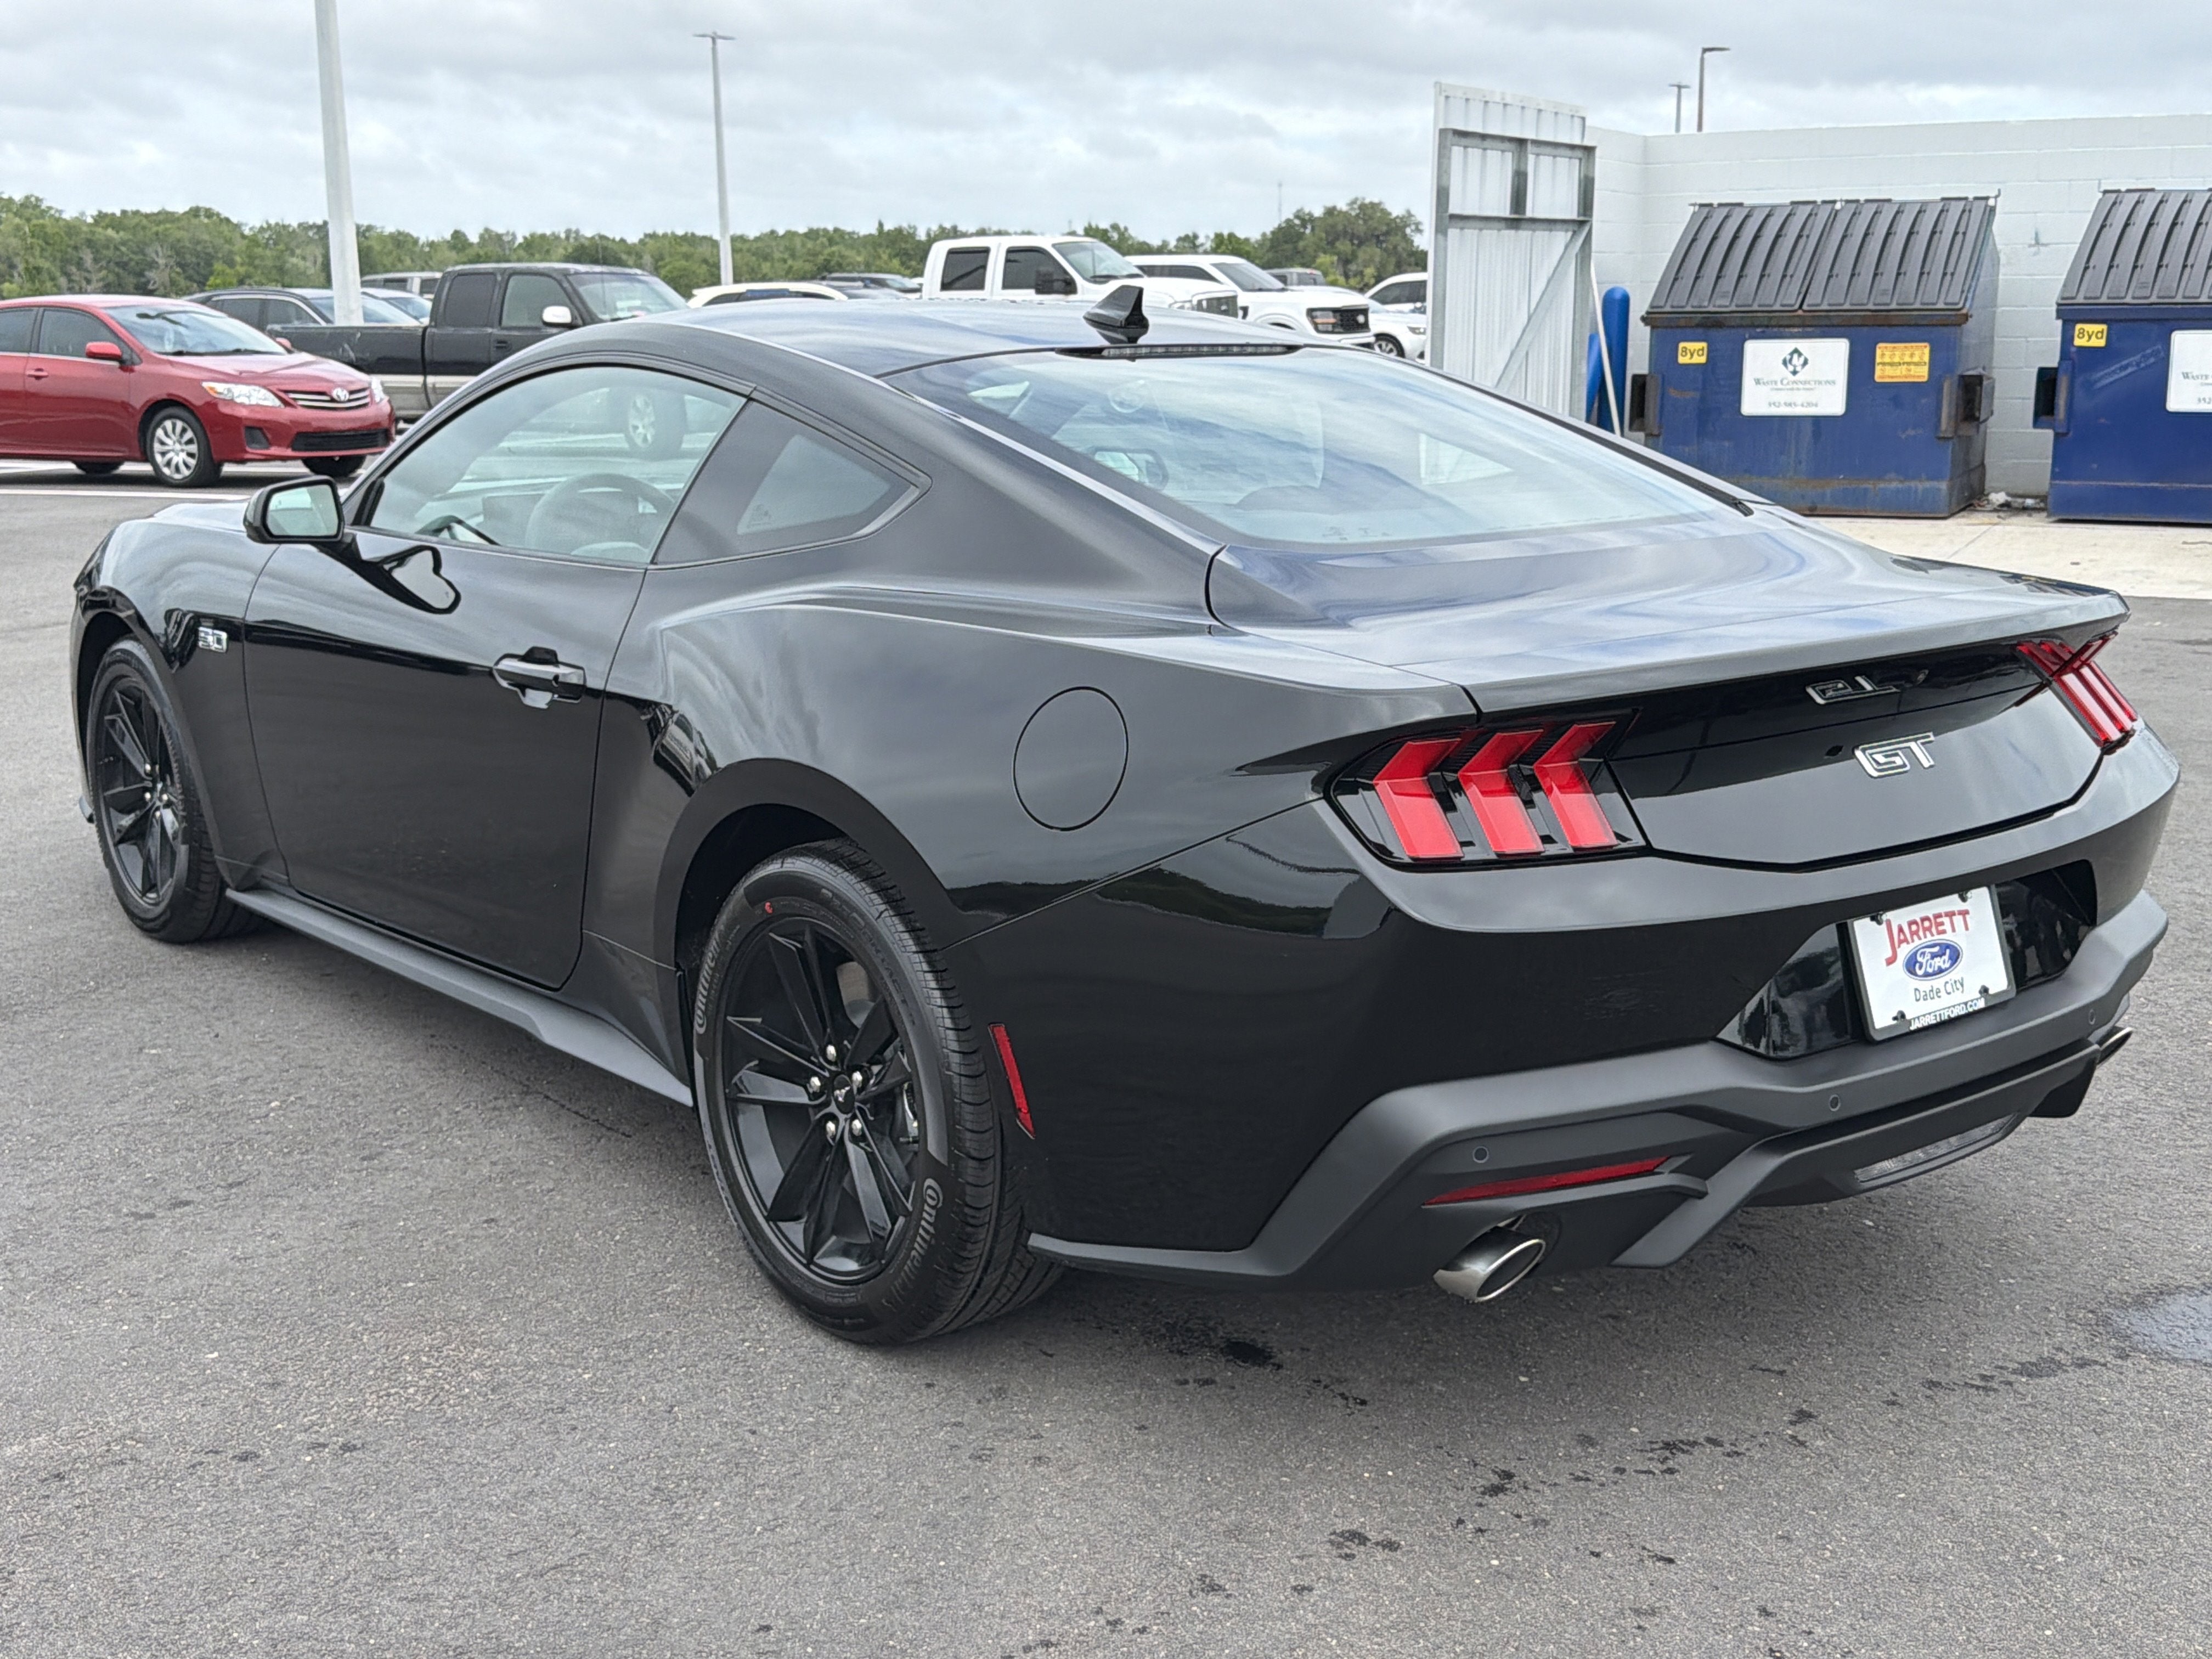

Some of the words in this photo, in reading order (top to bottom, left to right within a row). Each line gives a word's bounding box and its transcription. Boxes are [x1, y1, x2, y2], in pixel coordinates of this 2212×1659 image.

[2077, 328, 2104, 342] 8yd
[1680, 346, 1704, 360] 8yd
[1753, 377, 1778, 386] WASTE
[1780, 377, 1836, 386] CONNECTIONS
[1854, 731, 1936, 778] GT
[1884, 909, 1970, 967] JARRETT
[1915, 945, 1951, 976] Ford
[1914, 984, 1941, 1002] Dade
[1944, 977, 1965, 996] City
[1909, 998, 1985, 1030] JARRETTFORD.COM
